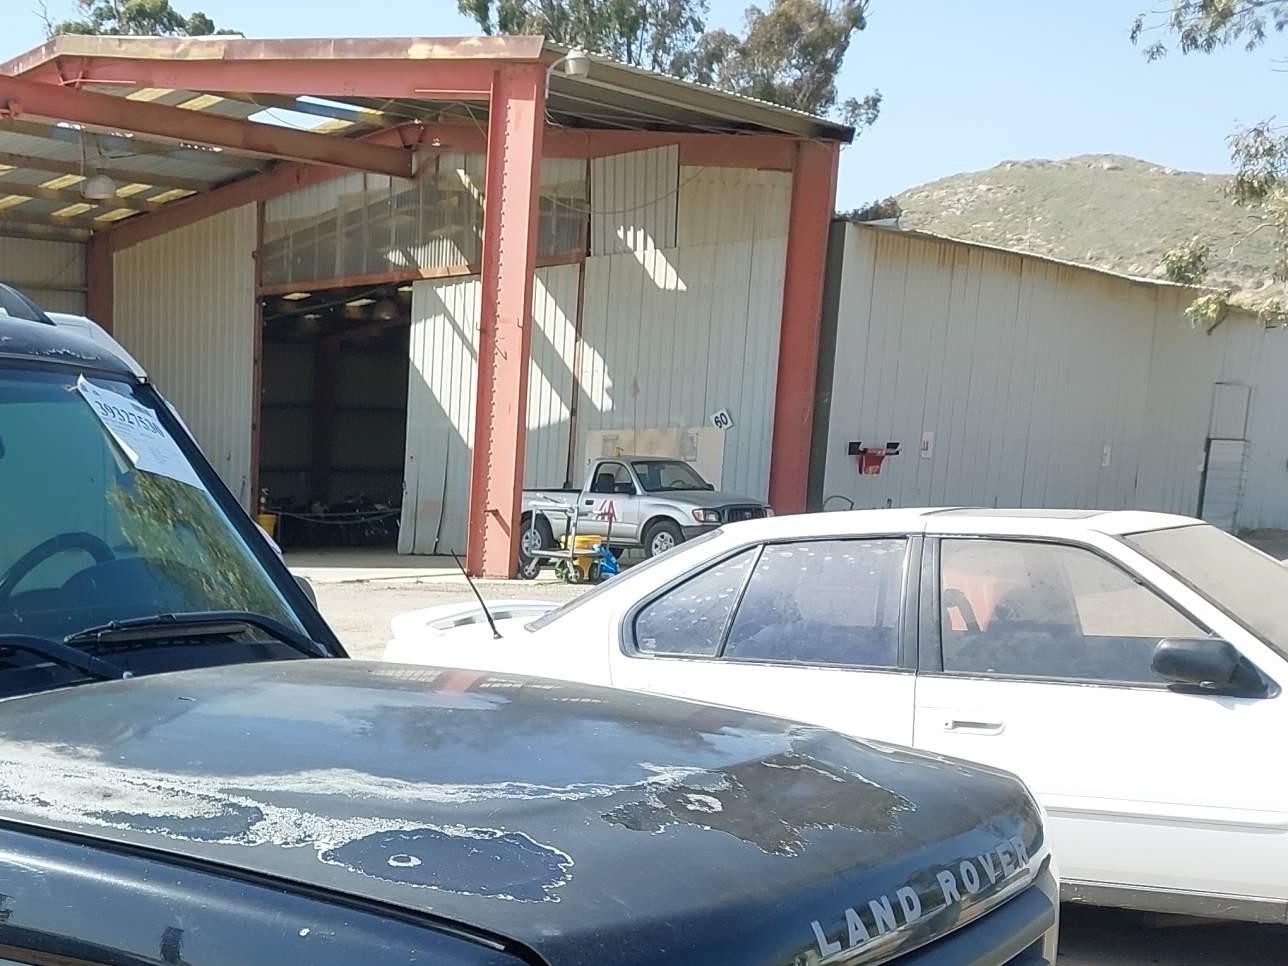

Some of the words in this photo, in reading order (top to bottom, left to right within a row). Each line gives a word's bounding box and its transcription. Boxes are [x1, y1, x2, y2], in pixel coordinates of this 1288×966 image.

[714, 412, 728, 429] 60
[810, 885, 922, 958] LAND
[935, 839, 1031, 906] ROVER
